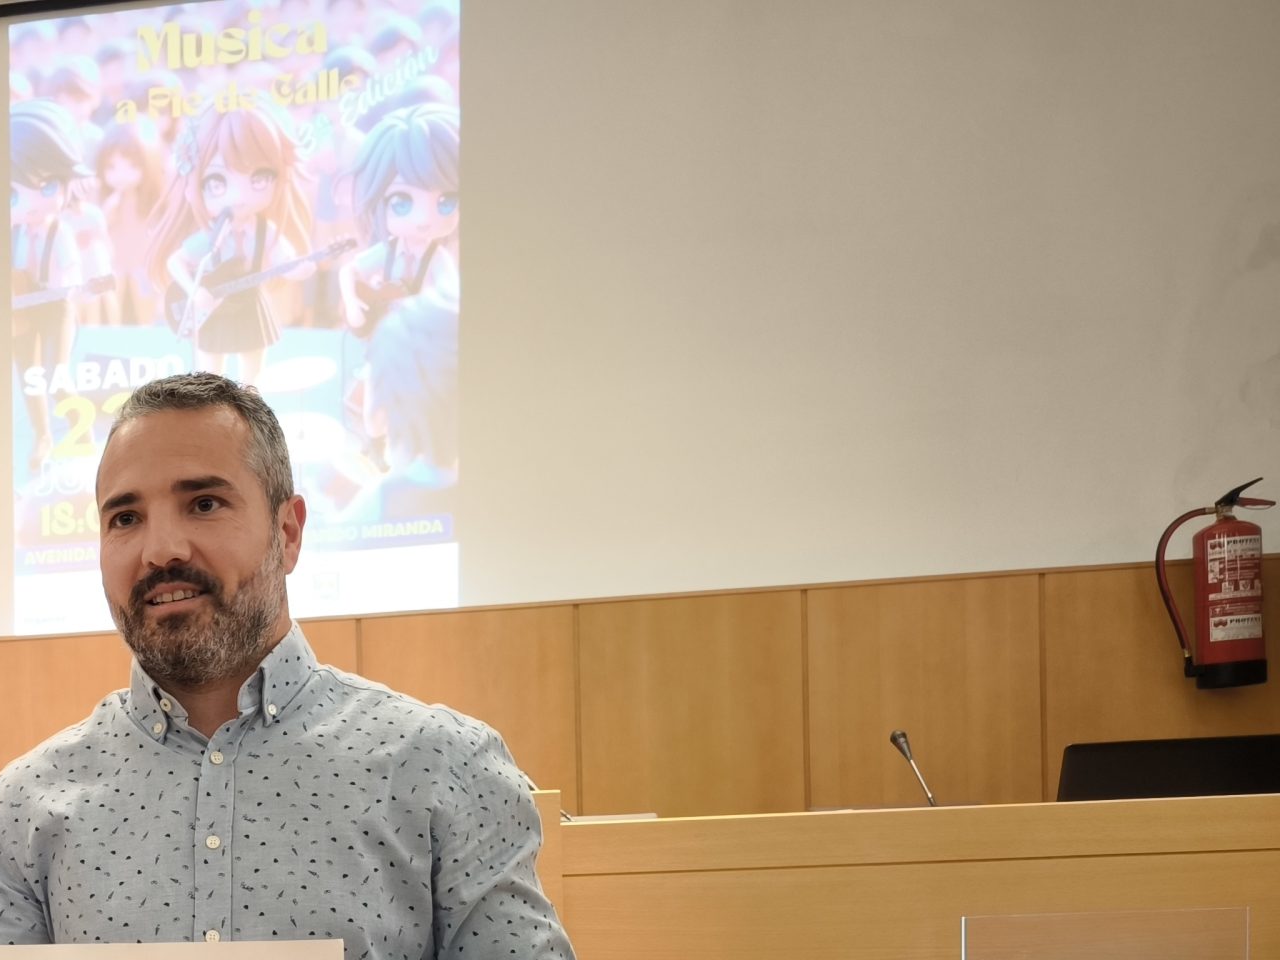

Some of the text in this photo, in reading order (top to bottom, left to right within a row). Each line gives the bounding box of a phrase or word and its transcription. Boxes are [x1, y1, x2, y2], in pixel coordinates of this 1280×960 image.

[115, 101, 137, 124] a
[215, 79, 257, 114] de
[362, 519, 443, 539] MIRANDA
[24, 547, 97, 566] AVENIDA
